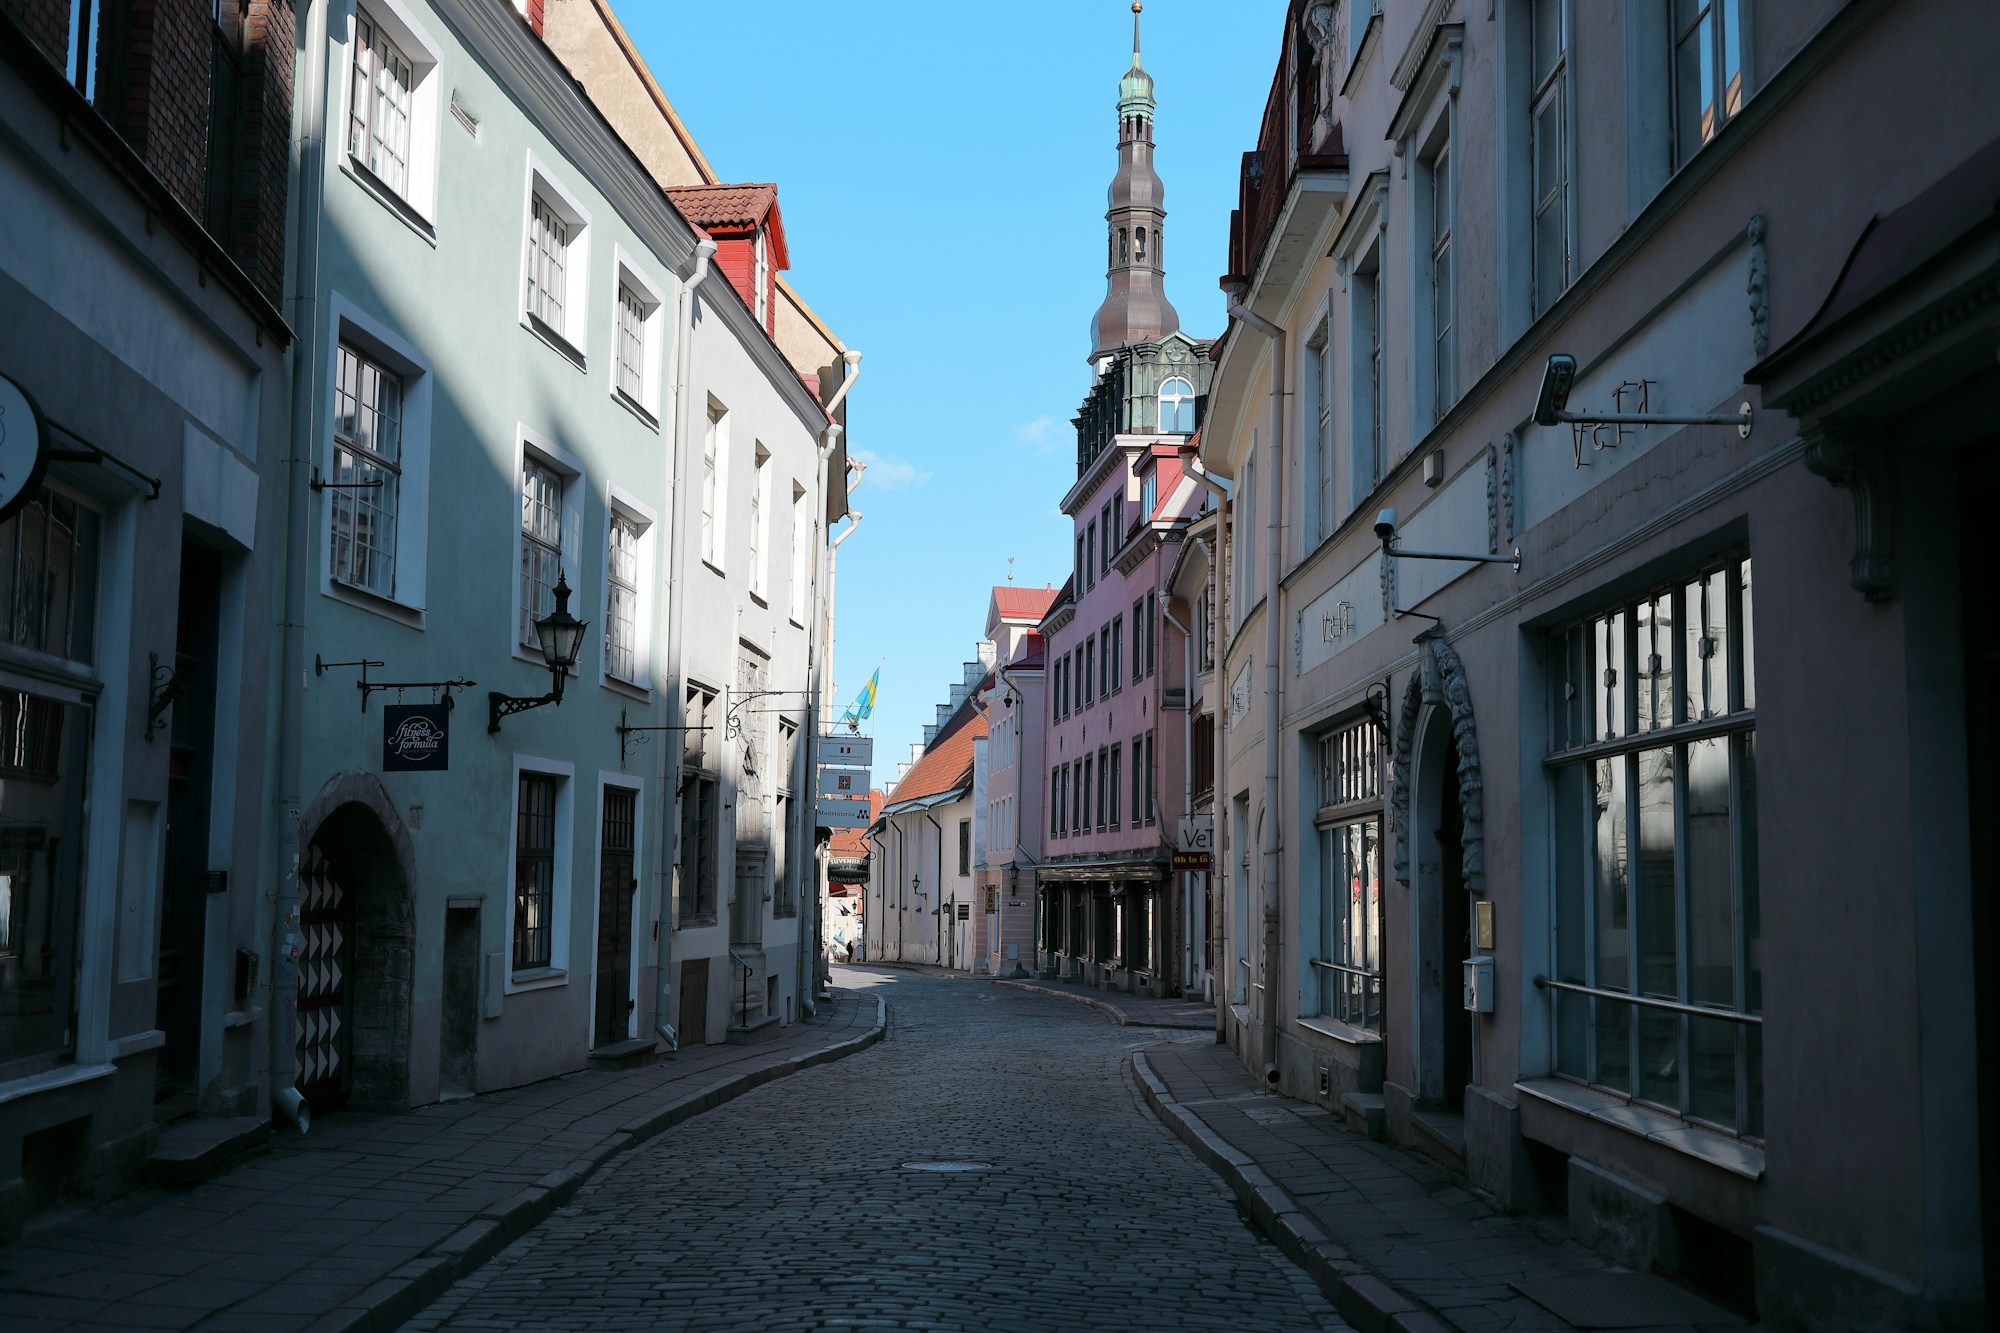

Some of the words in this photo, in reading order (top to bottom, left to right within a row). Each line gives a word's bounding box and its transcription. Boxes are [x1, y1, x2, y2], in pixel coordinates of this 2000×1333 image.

[389, 722, 431, 744] fitness
[396, 731, 444, 754] formula
[829, 875, 867, 883] SOUVENIRS
